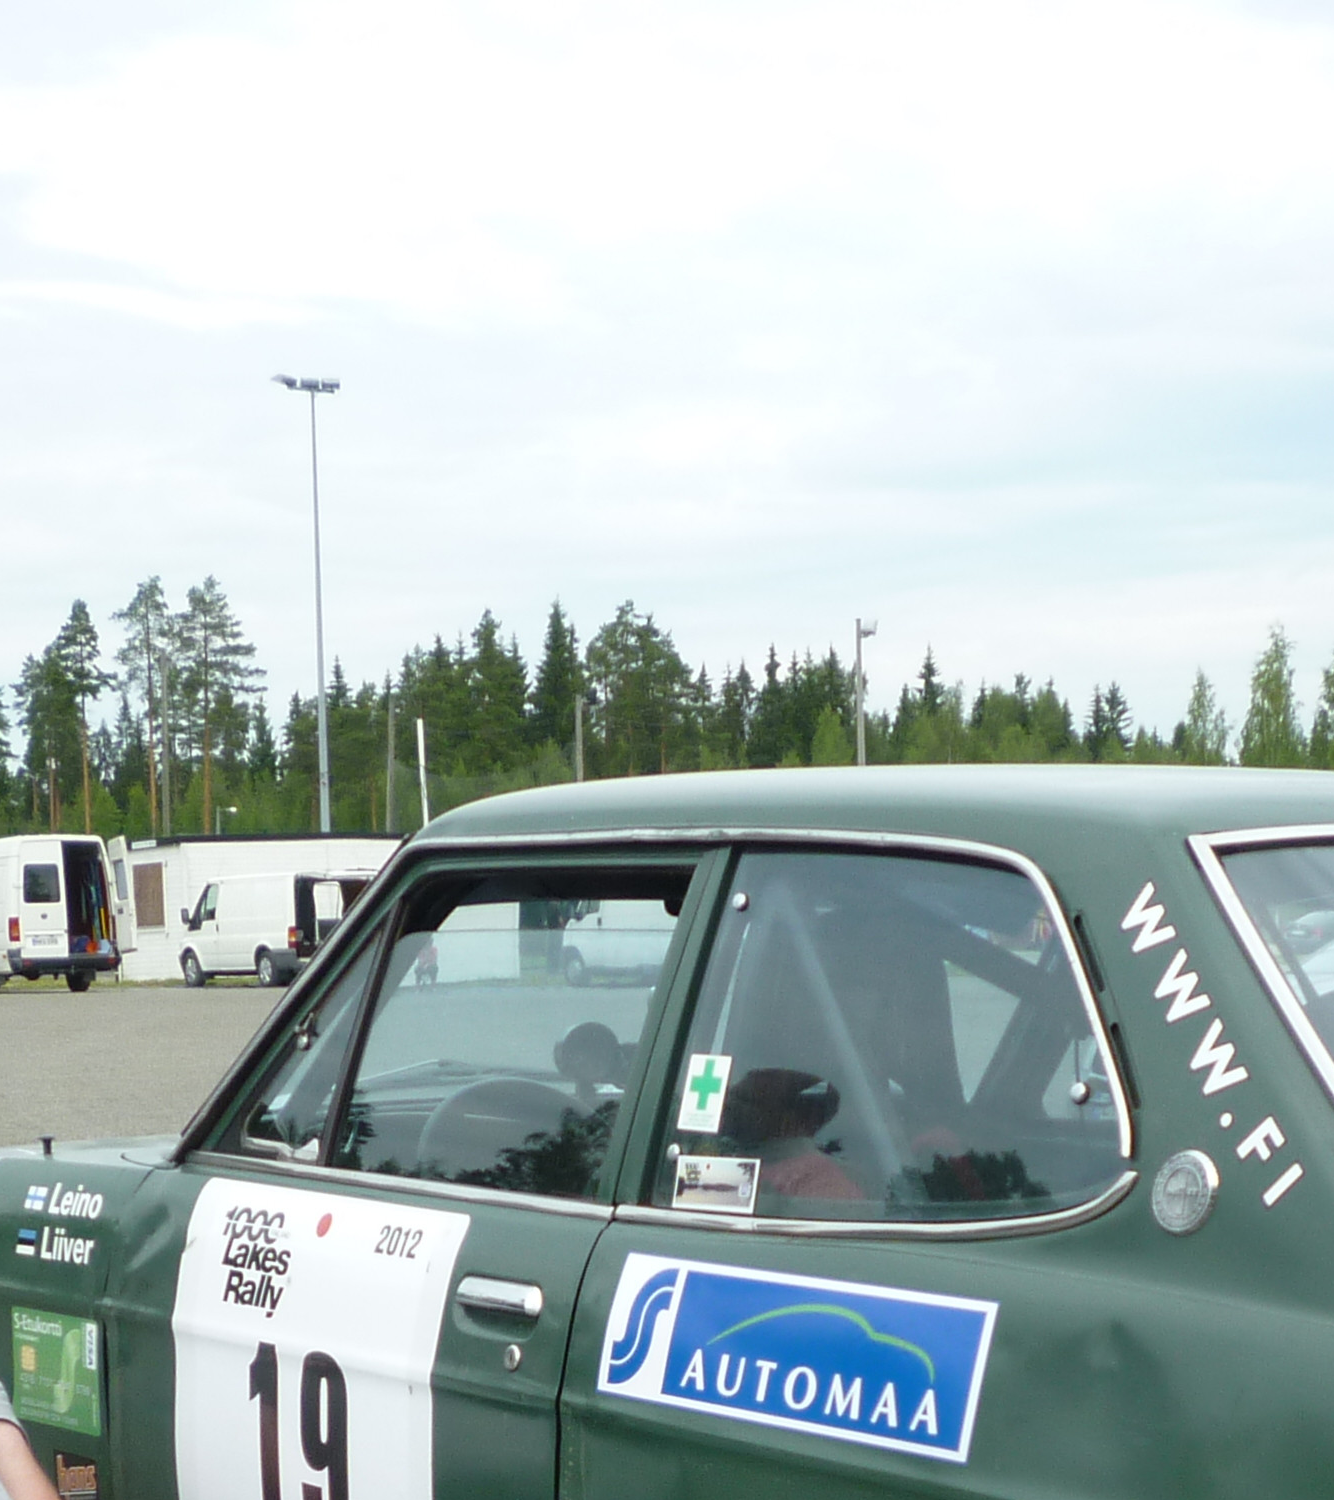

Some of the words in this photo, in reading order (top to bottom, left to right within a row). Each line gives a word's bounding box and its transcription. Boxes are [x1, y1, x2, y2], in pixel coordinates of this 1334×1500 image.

[1121, 880, 1304, 1207] WWW.FI
[48, 1182, 103, 1219] Leino
[40, 1226, 95, 1265] Liiver
[221, 1236, 291, 1276] Lakes
[373, 1225, 424, 1259] 2012
[222, 1269, 284, 1319] Rally
[86, 1328, 95, 1366] VISA
[680, 1347, 939, 1436] AUTOMAA
